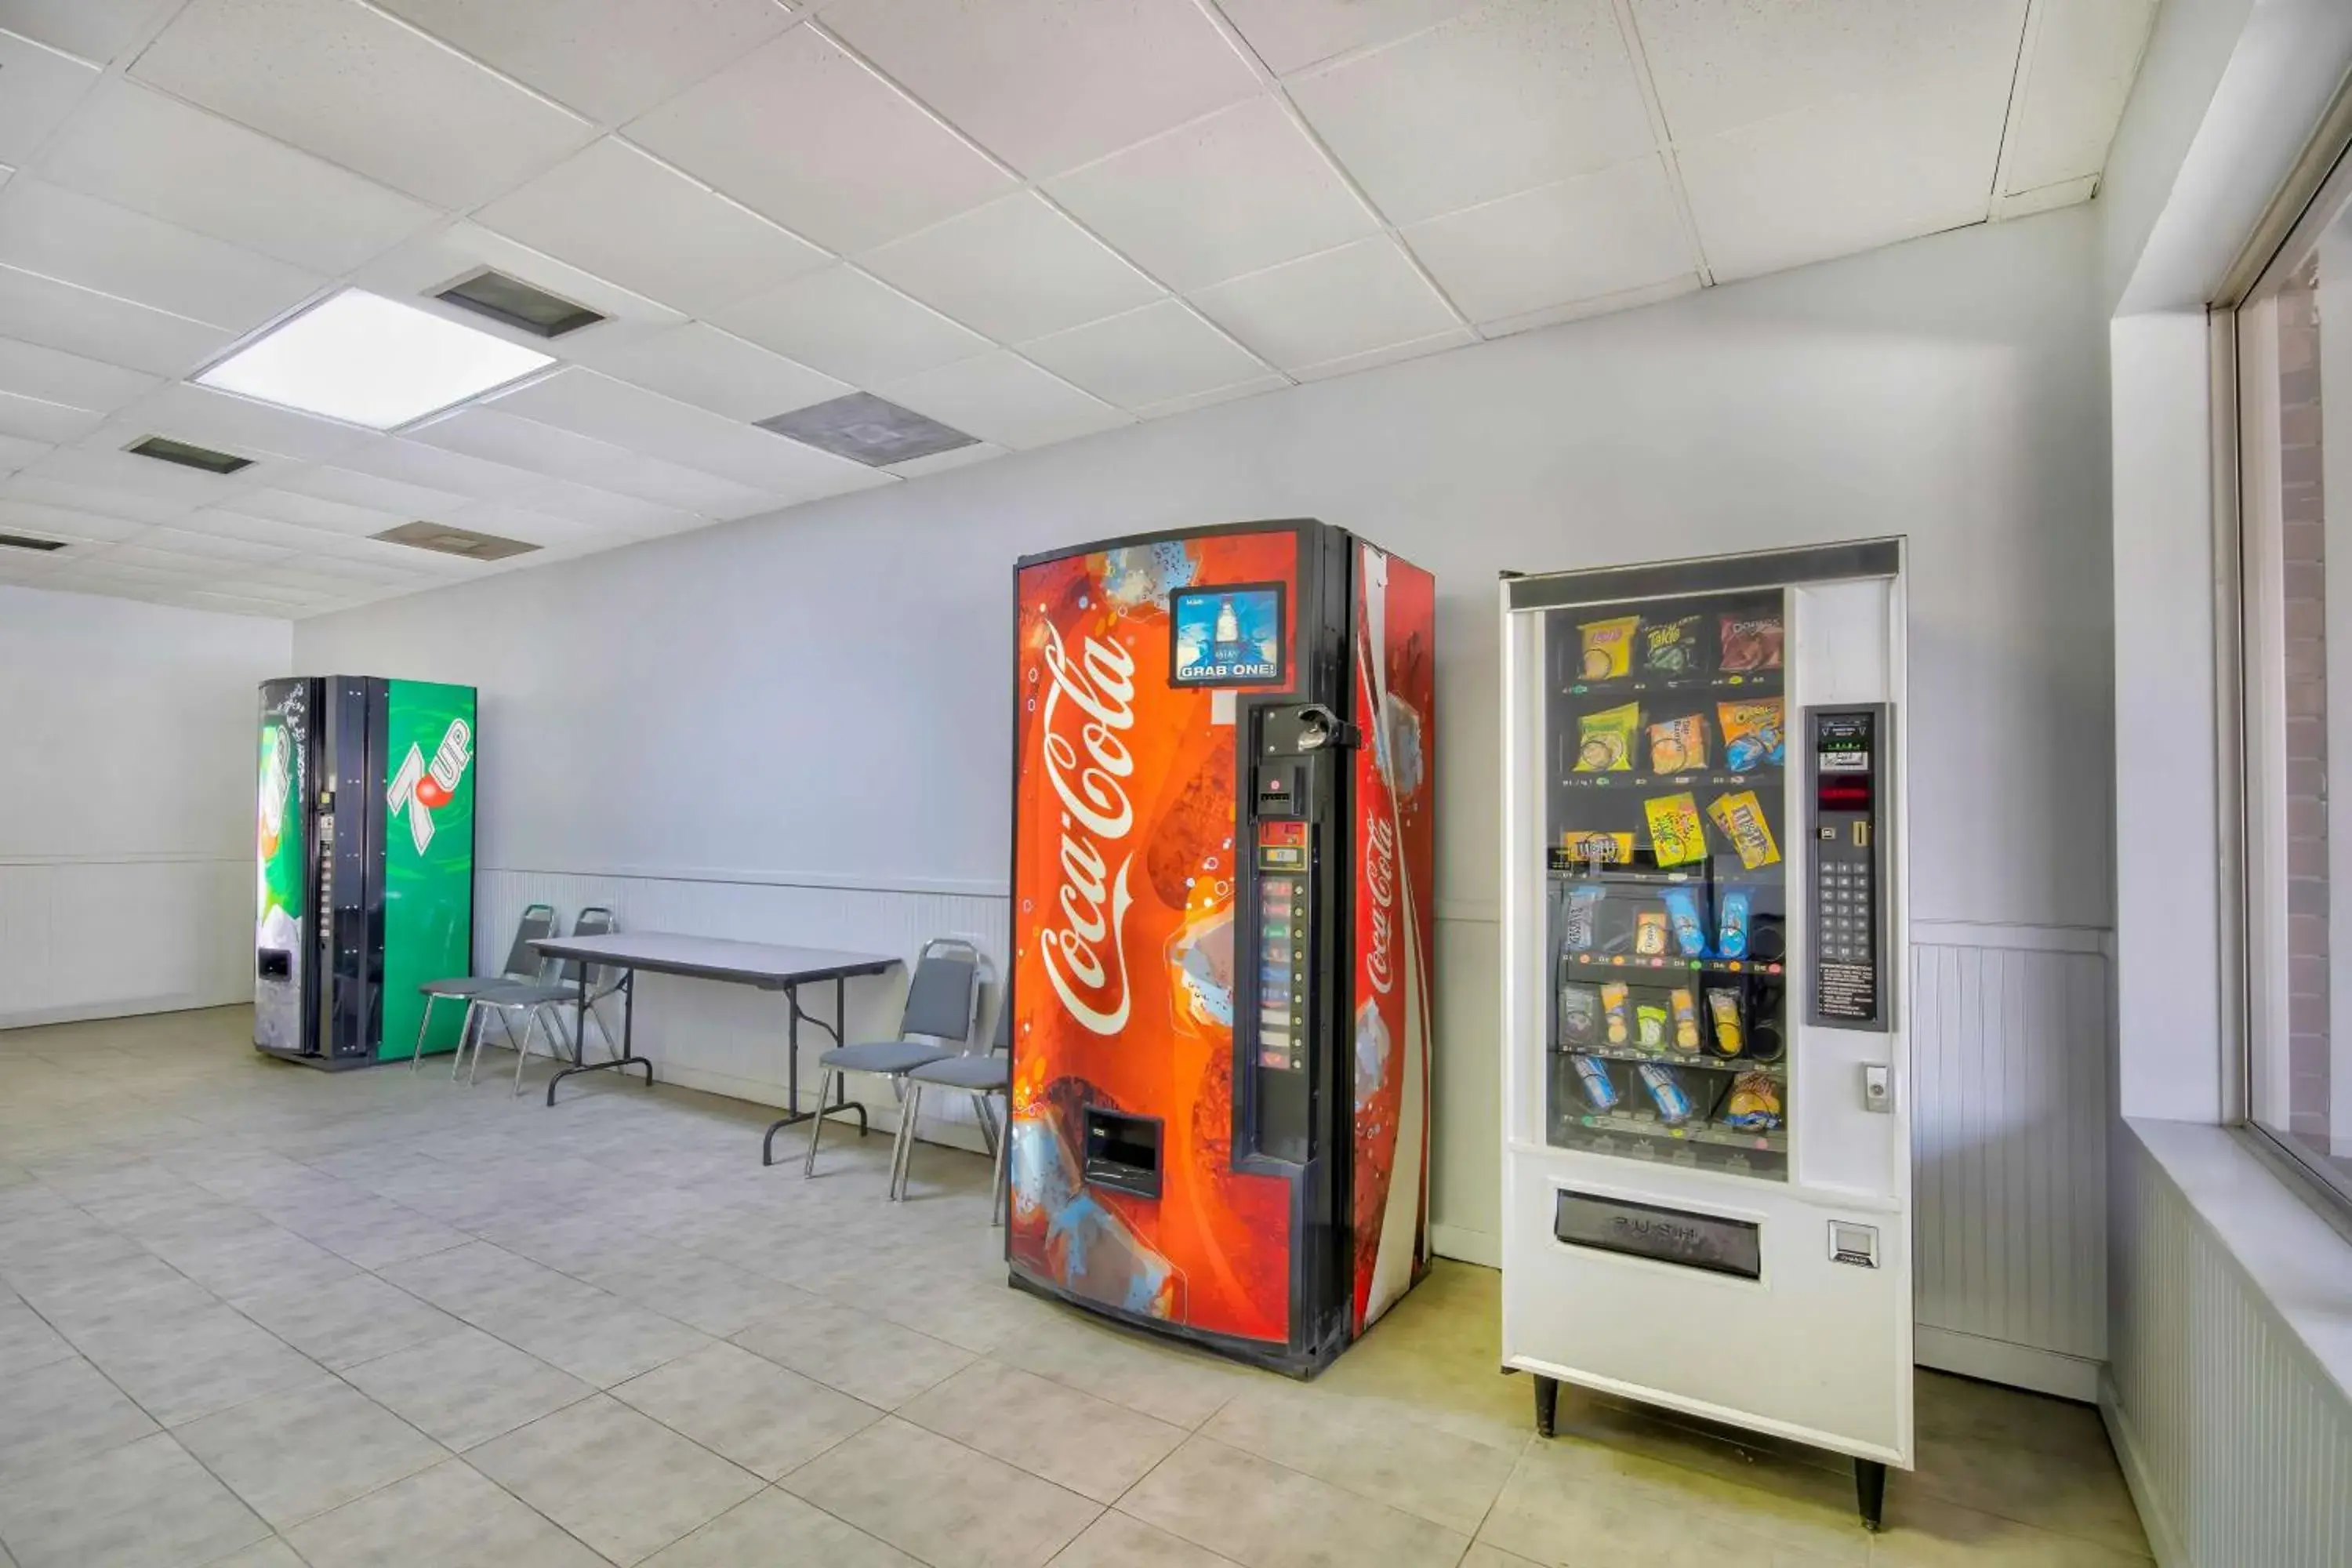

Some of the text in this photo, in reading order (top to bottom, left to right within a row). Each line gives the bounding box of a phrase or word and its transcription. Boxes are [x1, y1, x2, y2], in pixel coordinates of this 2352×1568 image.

[1181, 664, 1275, 677] GRAB ONE!
[1042, 618, 1135, 1036] Coca-Cola
[1367, 807, 1393, 994] Coca-Cola
